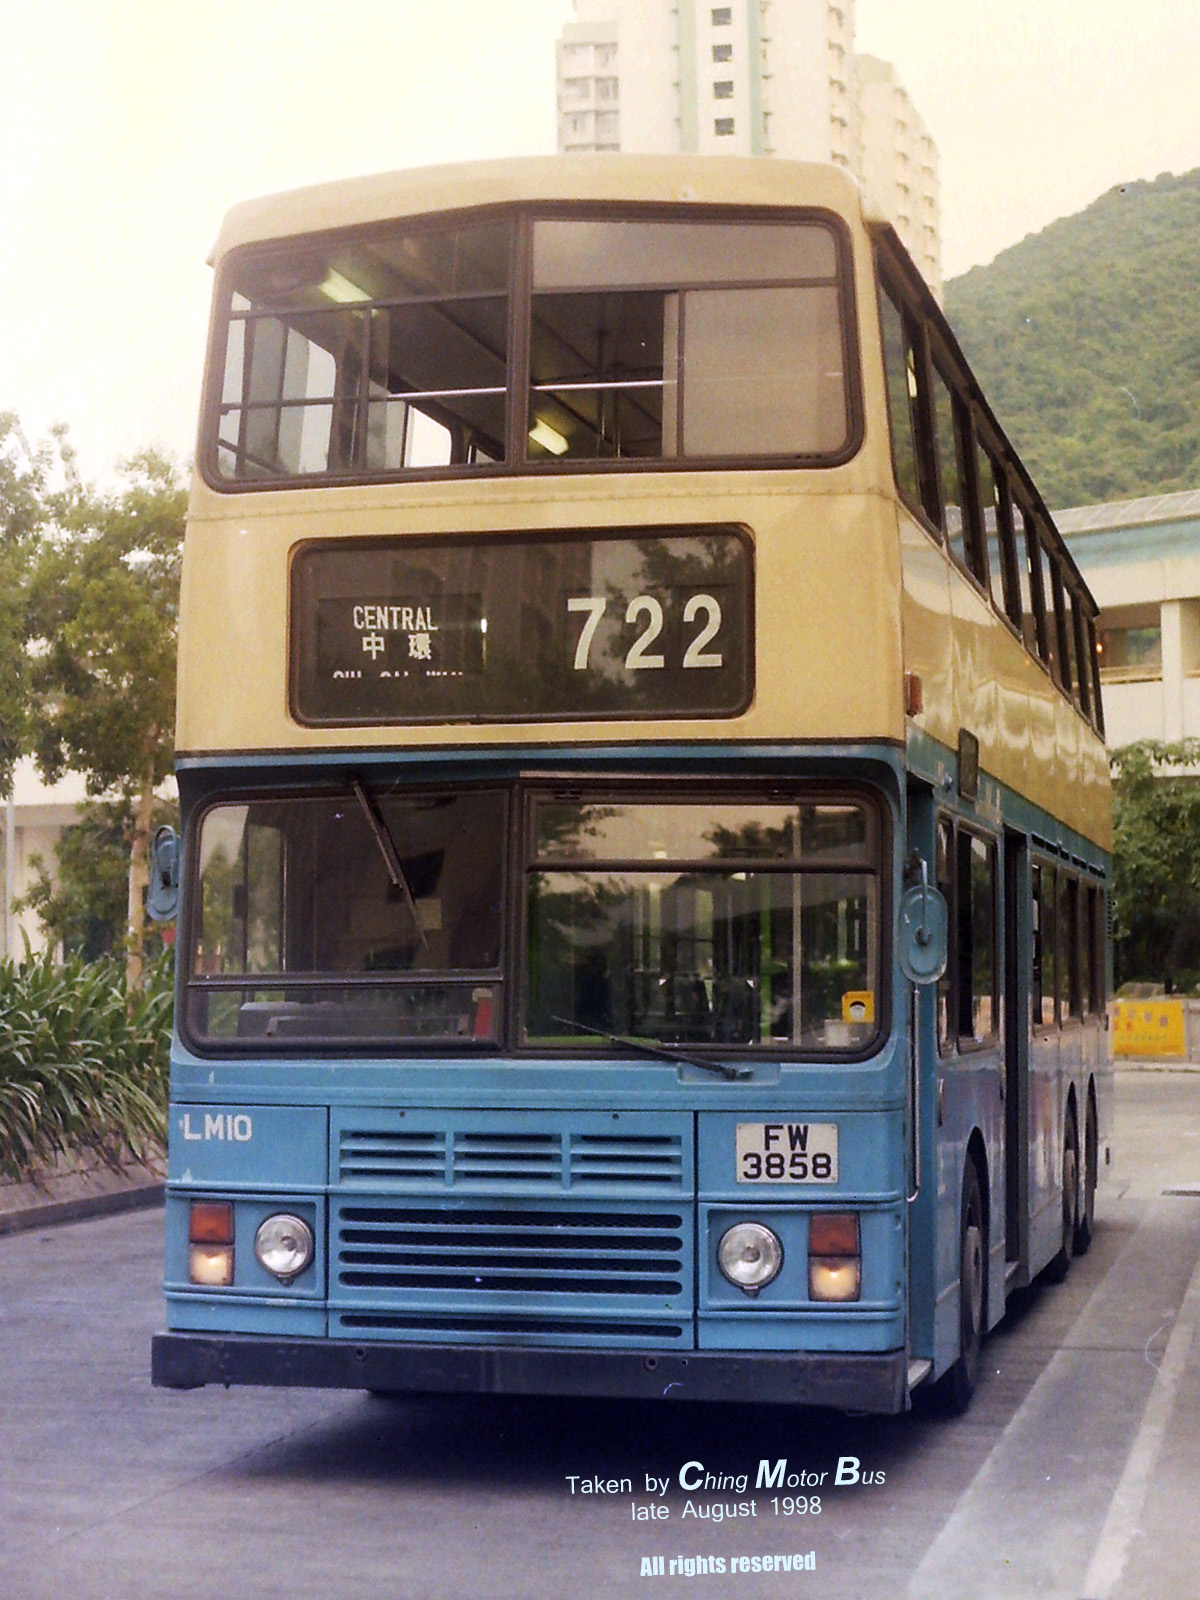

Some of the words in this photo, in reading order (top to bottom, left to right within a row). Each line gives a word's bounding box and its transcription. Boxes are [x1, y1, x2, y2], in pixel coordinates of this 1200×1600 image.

[353, 605, 438, 631] CENTRAL
[567, 594, 724, 670] 722
[764, 1124, 809, 1151] FW
[743, 1153, 831, 1179] 3858
